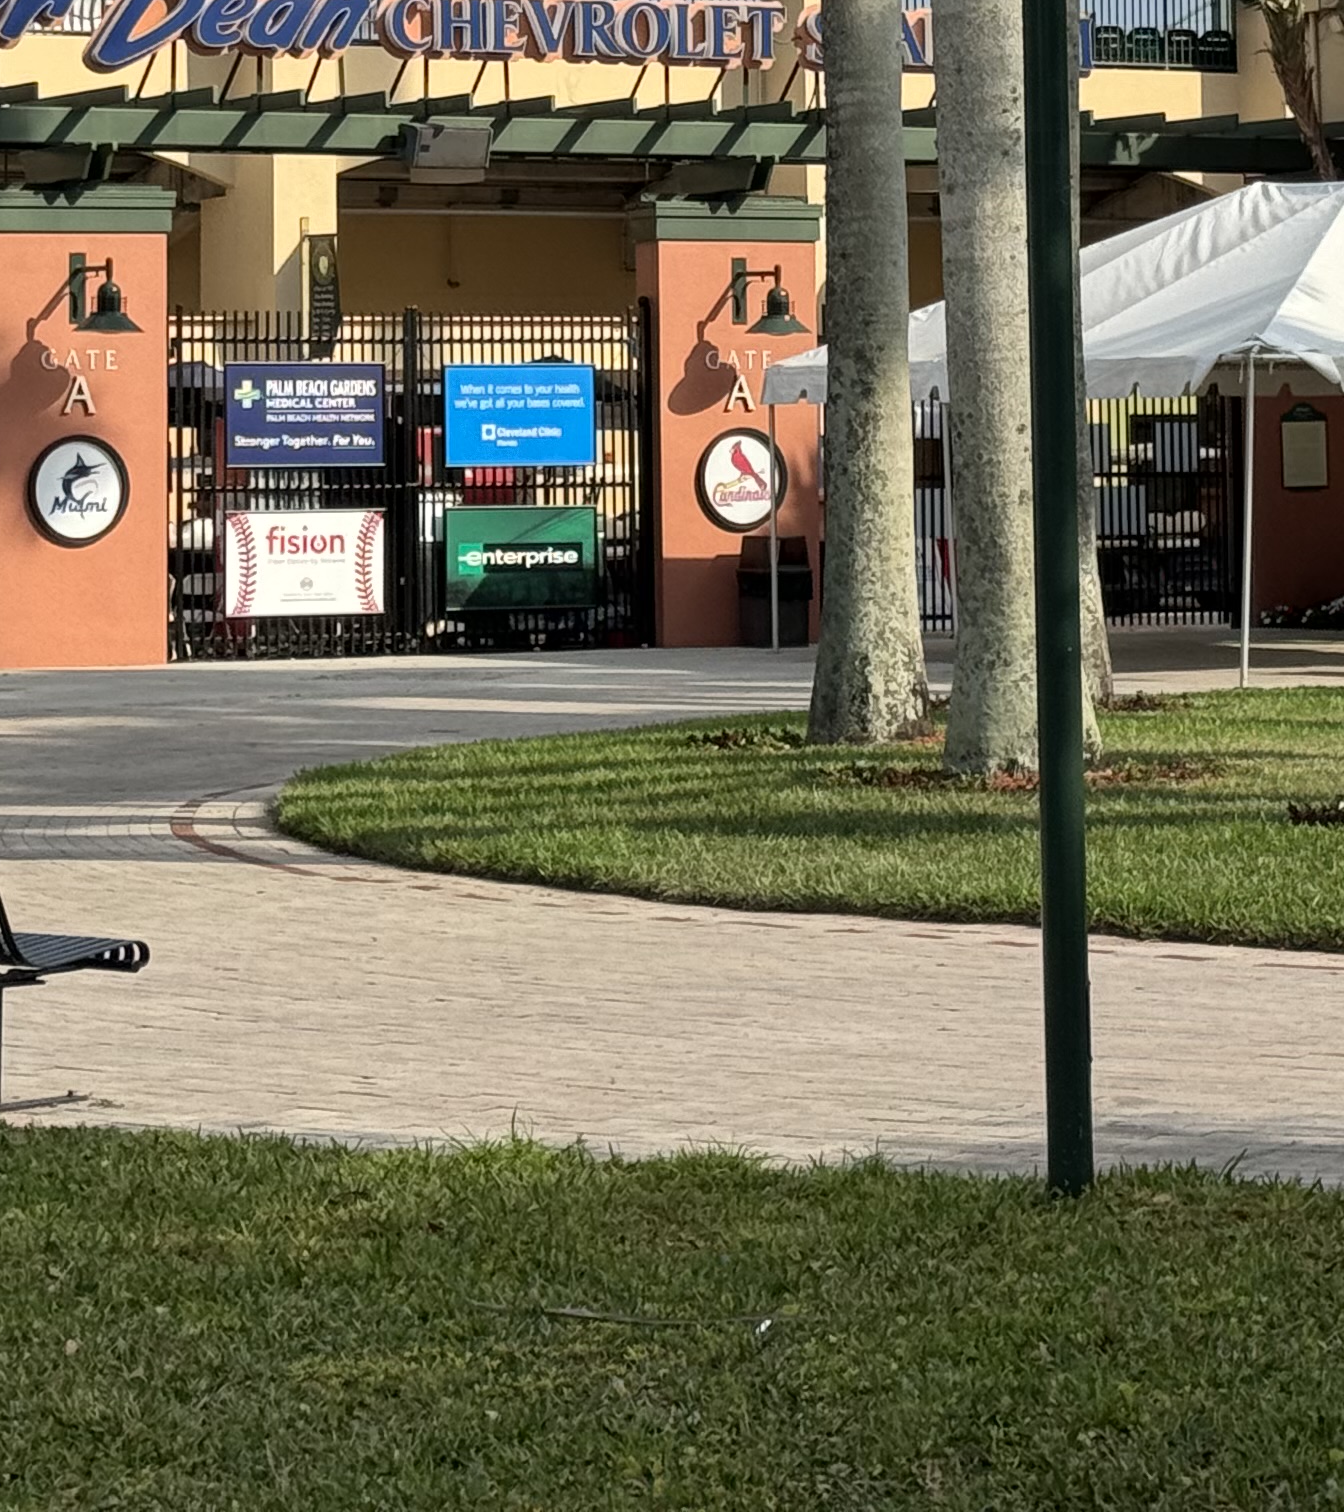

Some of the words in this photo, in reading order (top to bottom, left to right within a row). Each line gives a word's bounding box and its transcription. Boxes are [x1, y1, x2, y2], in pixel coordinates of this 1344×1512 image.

[41, 349, 118, 370] GATE
[706, 350, 772, 370] GATE
[62, 375, 96, 415] A
[266, 380, 294, 396] PALM
[296, 380, 328, 396] BEACH
[330, 380, 377, 396] GARDENS
[460, 384, 485, 394] When
[495, 385, 522, 395] comes
[524, 384, 534, 394] to
[534, 385, 553, 396] your
[554, 384, 580, 394] health
[725, 374, 756, 412] A
[266, 398, 312, 408] MEDICAL
[315, 398, 356, 408] CENTER
[507, 399, 525, 410] your
[266, 414, 286, 423] PALM
[287, 414, 311, 423] BEACH
[312, 414, 339, 423] HEALTH
[340, 414, 375, 423] NETWORK
[234, 435, 280, 450] Stronger
[282, 434, 331, 450] Together.
[333, 434, 350, 446] For
[352, 434, 376, 446] You.
[497, 427, 537, 437] Cleveland
[539, 427, 563, 437] Clinic
[712, 482, 771, 507] Cardinals
[48, 493, 108, 518] Miami
[265, 525, 345, 555] fision
[459, 546, 579, 568] enterprise
